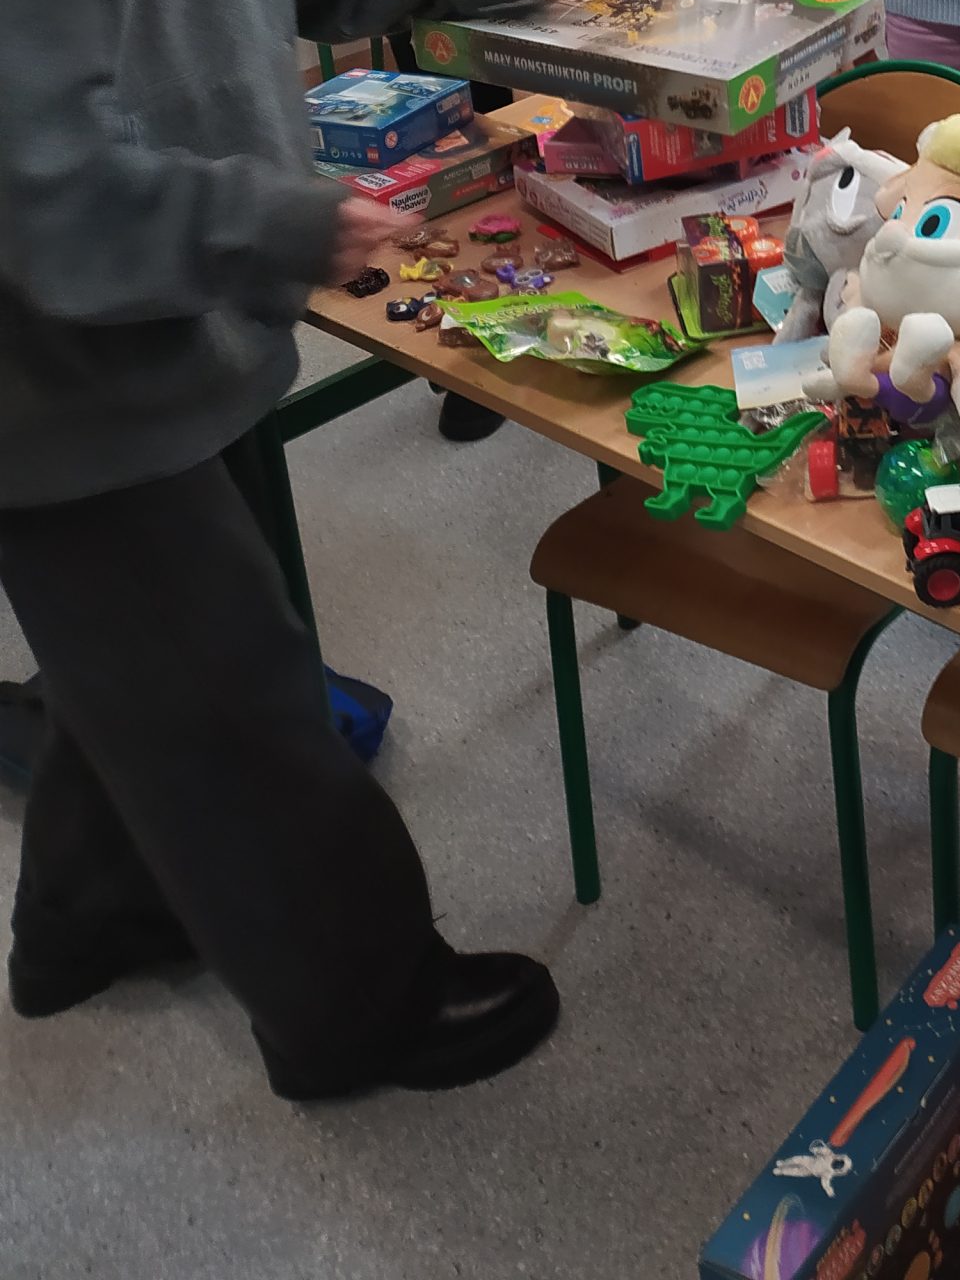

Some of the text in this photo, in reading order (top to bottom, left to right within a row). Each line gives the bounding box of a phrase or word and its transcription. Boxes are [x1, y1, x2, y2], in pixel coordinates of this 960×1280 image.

[484, 50, 638, 95] MAŁY KONSTRUKTOR PROFI
[391, 188, 429, 208] Naukowa
